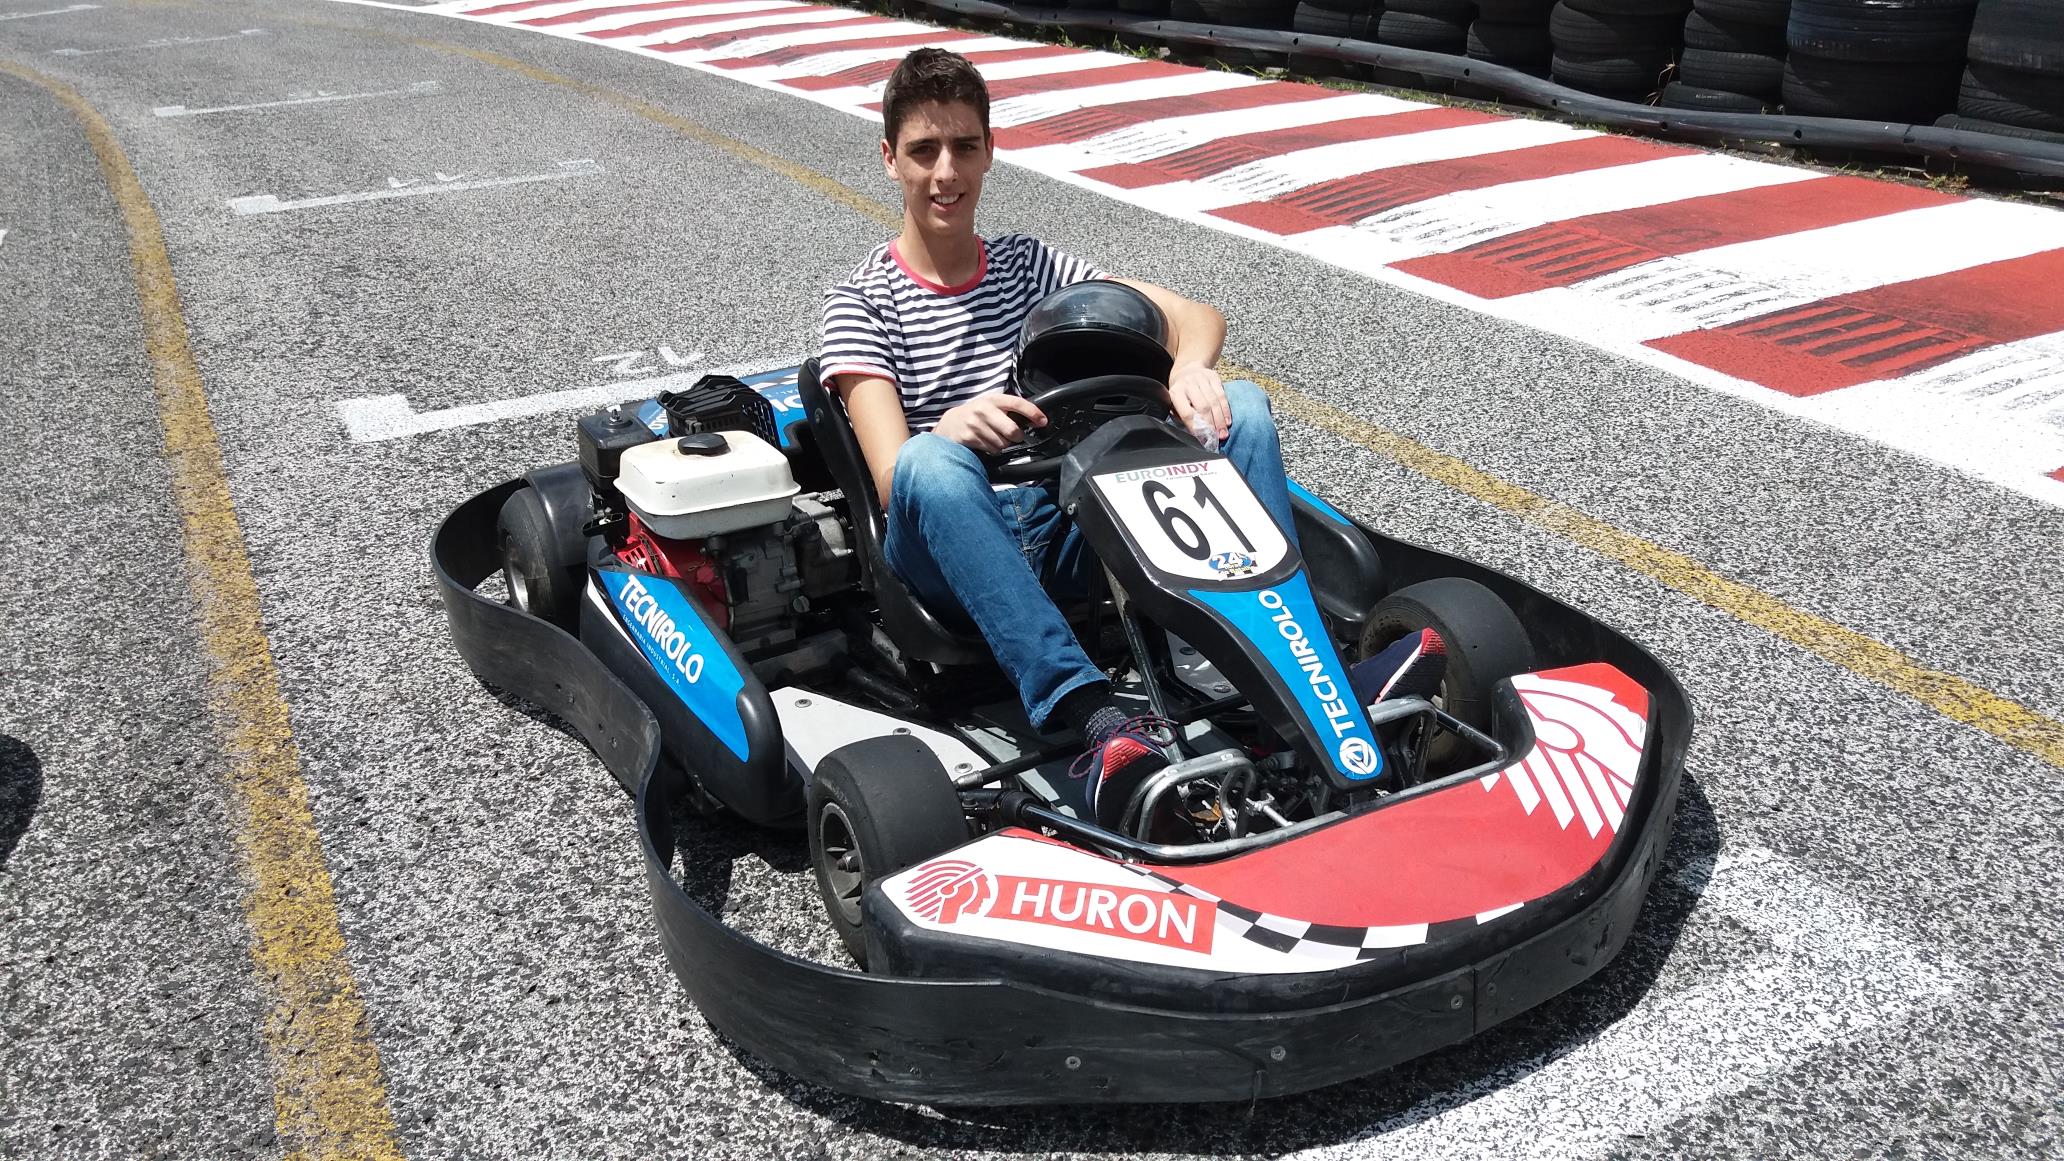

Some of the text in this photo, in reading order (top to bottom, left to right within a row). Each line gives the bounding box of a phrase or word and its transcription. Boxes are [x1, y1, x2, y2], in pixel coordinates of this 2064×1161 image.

[1115, 462, 1209, 484] EUROINDY
[1142, 475, 1258, 561] 61
[619, 574, 705, 684] TECNIROLO
[1258, 589, 1356, 739] TECNIROLO
[1011, 881, 1197, 944] HURON
